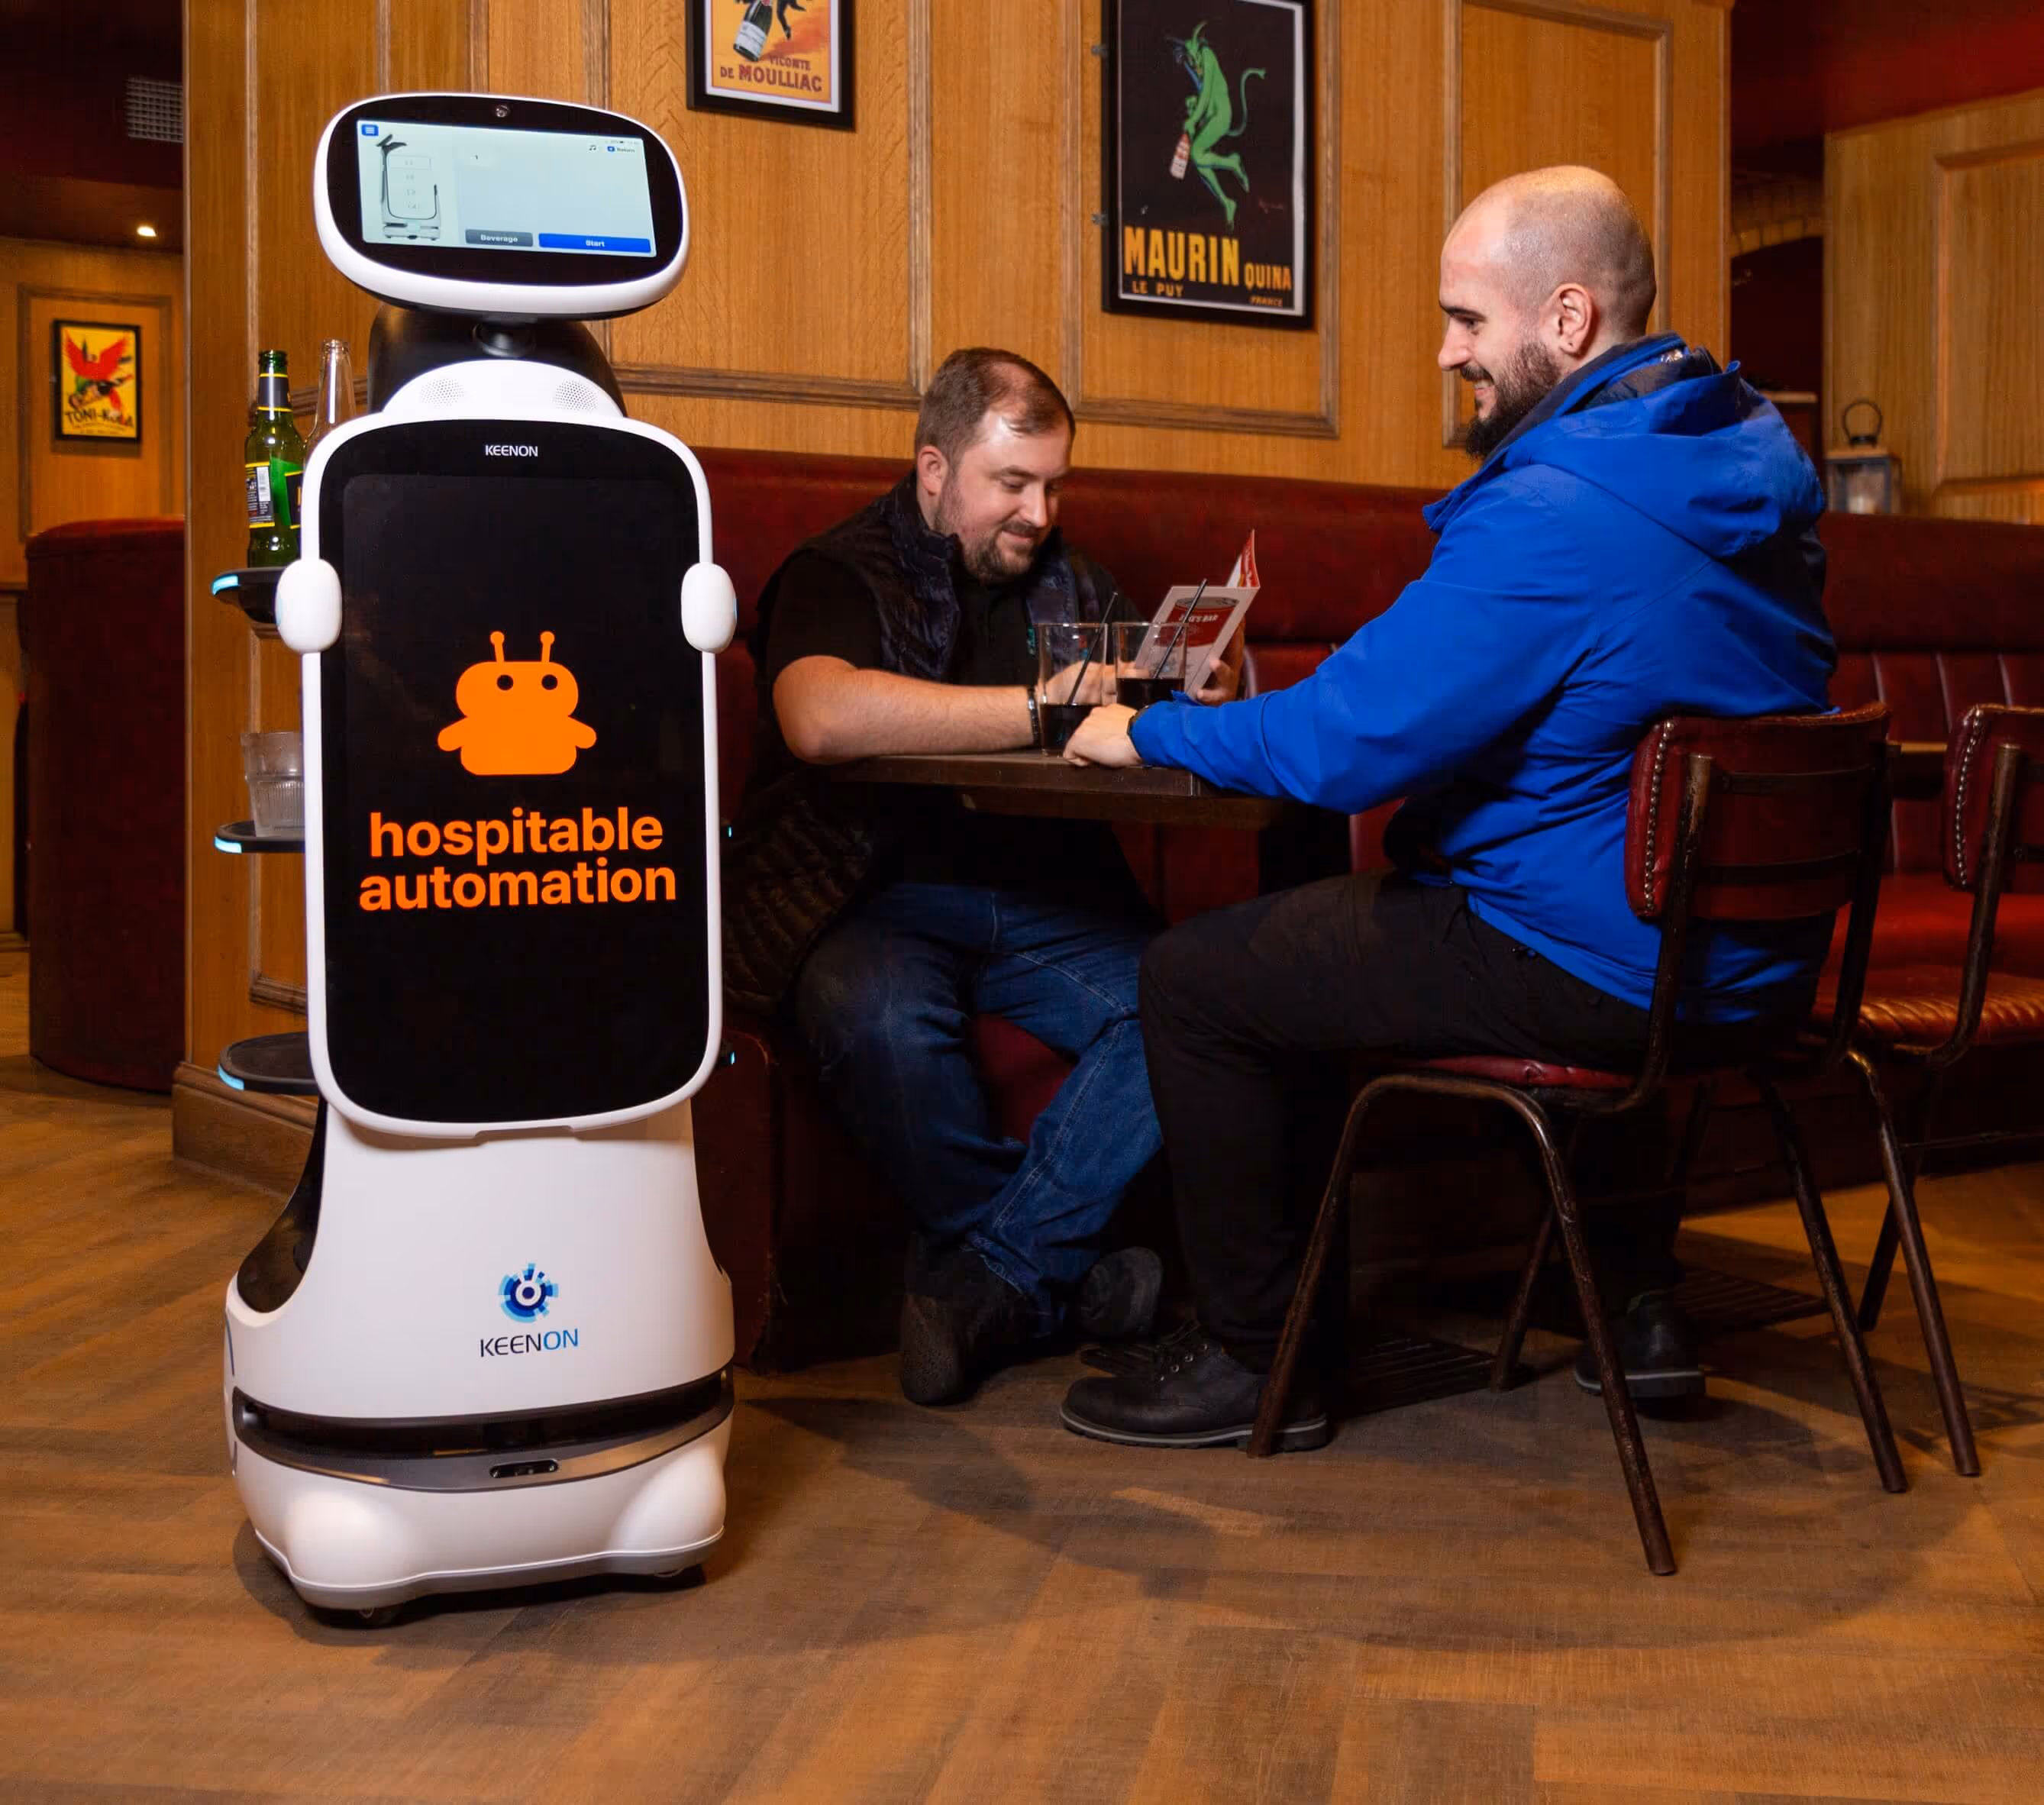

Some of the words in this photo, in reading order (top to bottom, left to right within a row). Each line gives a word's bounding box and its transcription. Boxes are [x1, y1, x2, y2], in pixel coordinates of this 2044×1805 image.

[720, 66, 735, 79] DE
[738, 63, 822, 92] MOULLIAC
[480, 234, 518, 243] Beverage
[585, 239, 605, 248] Start
[1124, 226, 1240, 287] MAURIN
[1245, 262, 1292, 292] QUINA
[1132, 280, 1148, 294] LE
[1155, 282, 1184, 298] PUY
[485, 444, 538, 457] KEENON
[370, 806, 664, 867] hospitable
[359, 857, 676, 911] automation
[480, 1327, 579, 1358] KEENON
